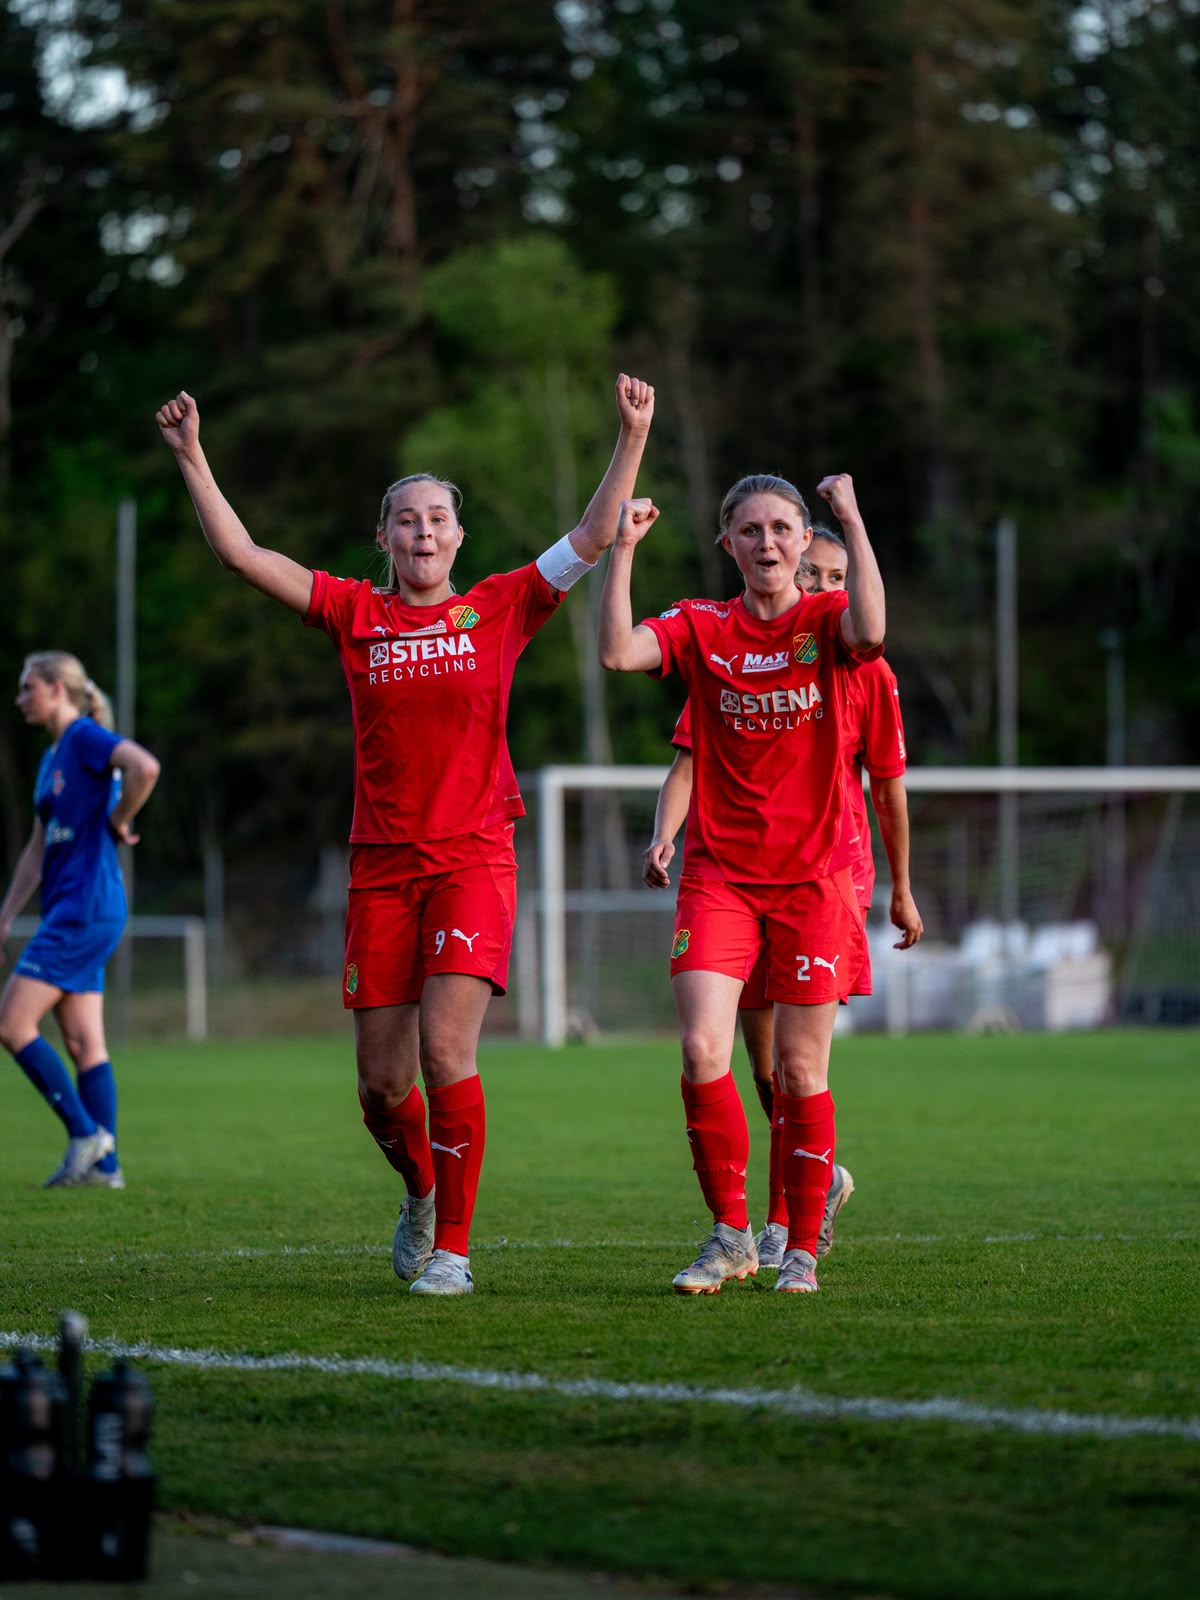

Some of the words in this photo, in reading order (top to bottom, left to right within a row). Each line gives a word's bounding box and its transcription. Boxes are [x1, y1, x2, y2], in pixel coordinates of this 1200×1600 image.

[391, 633, 477, 664] STENA
[368, 657, 477, 686] RECYCLING
[741, 681, 823, 714] STENA
[434, 929, 446, 955] 9
[795, 954, 811, 981] 2
